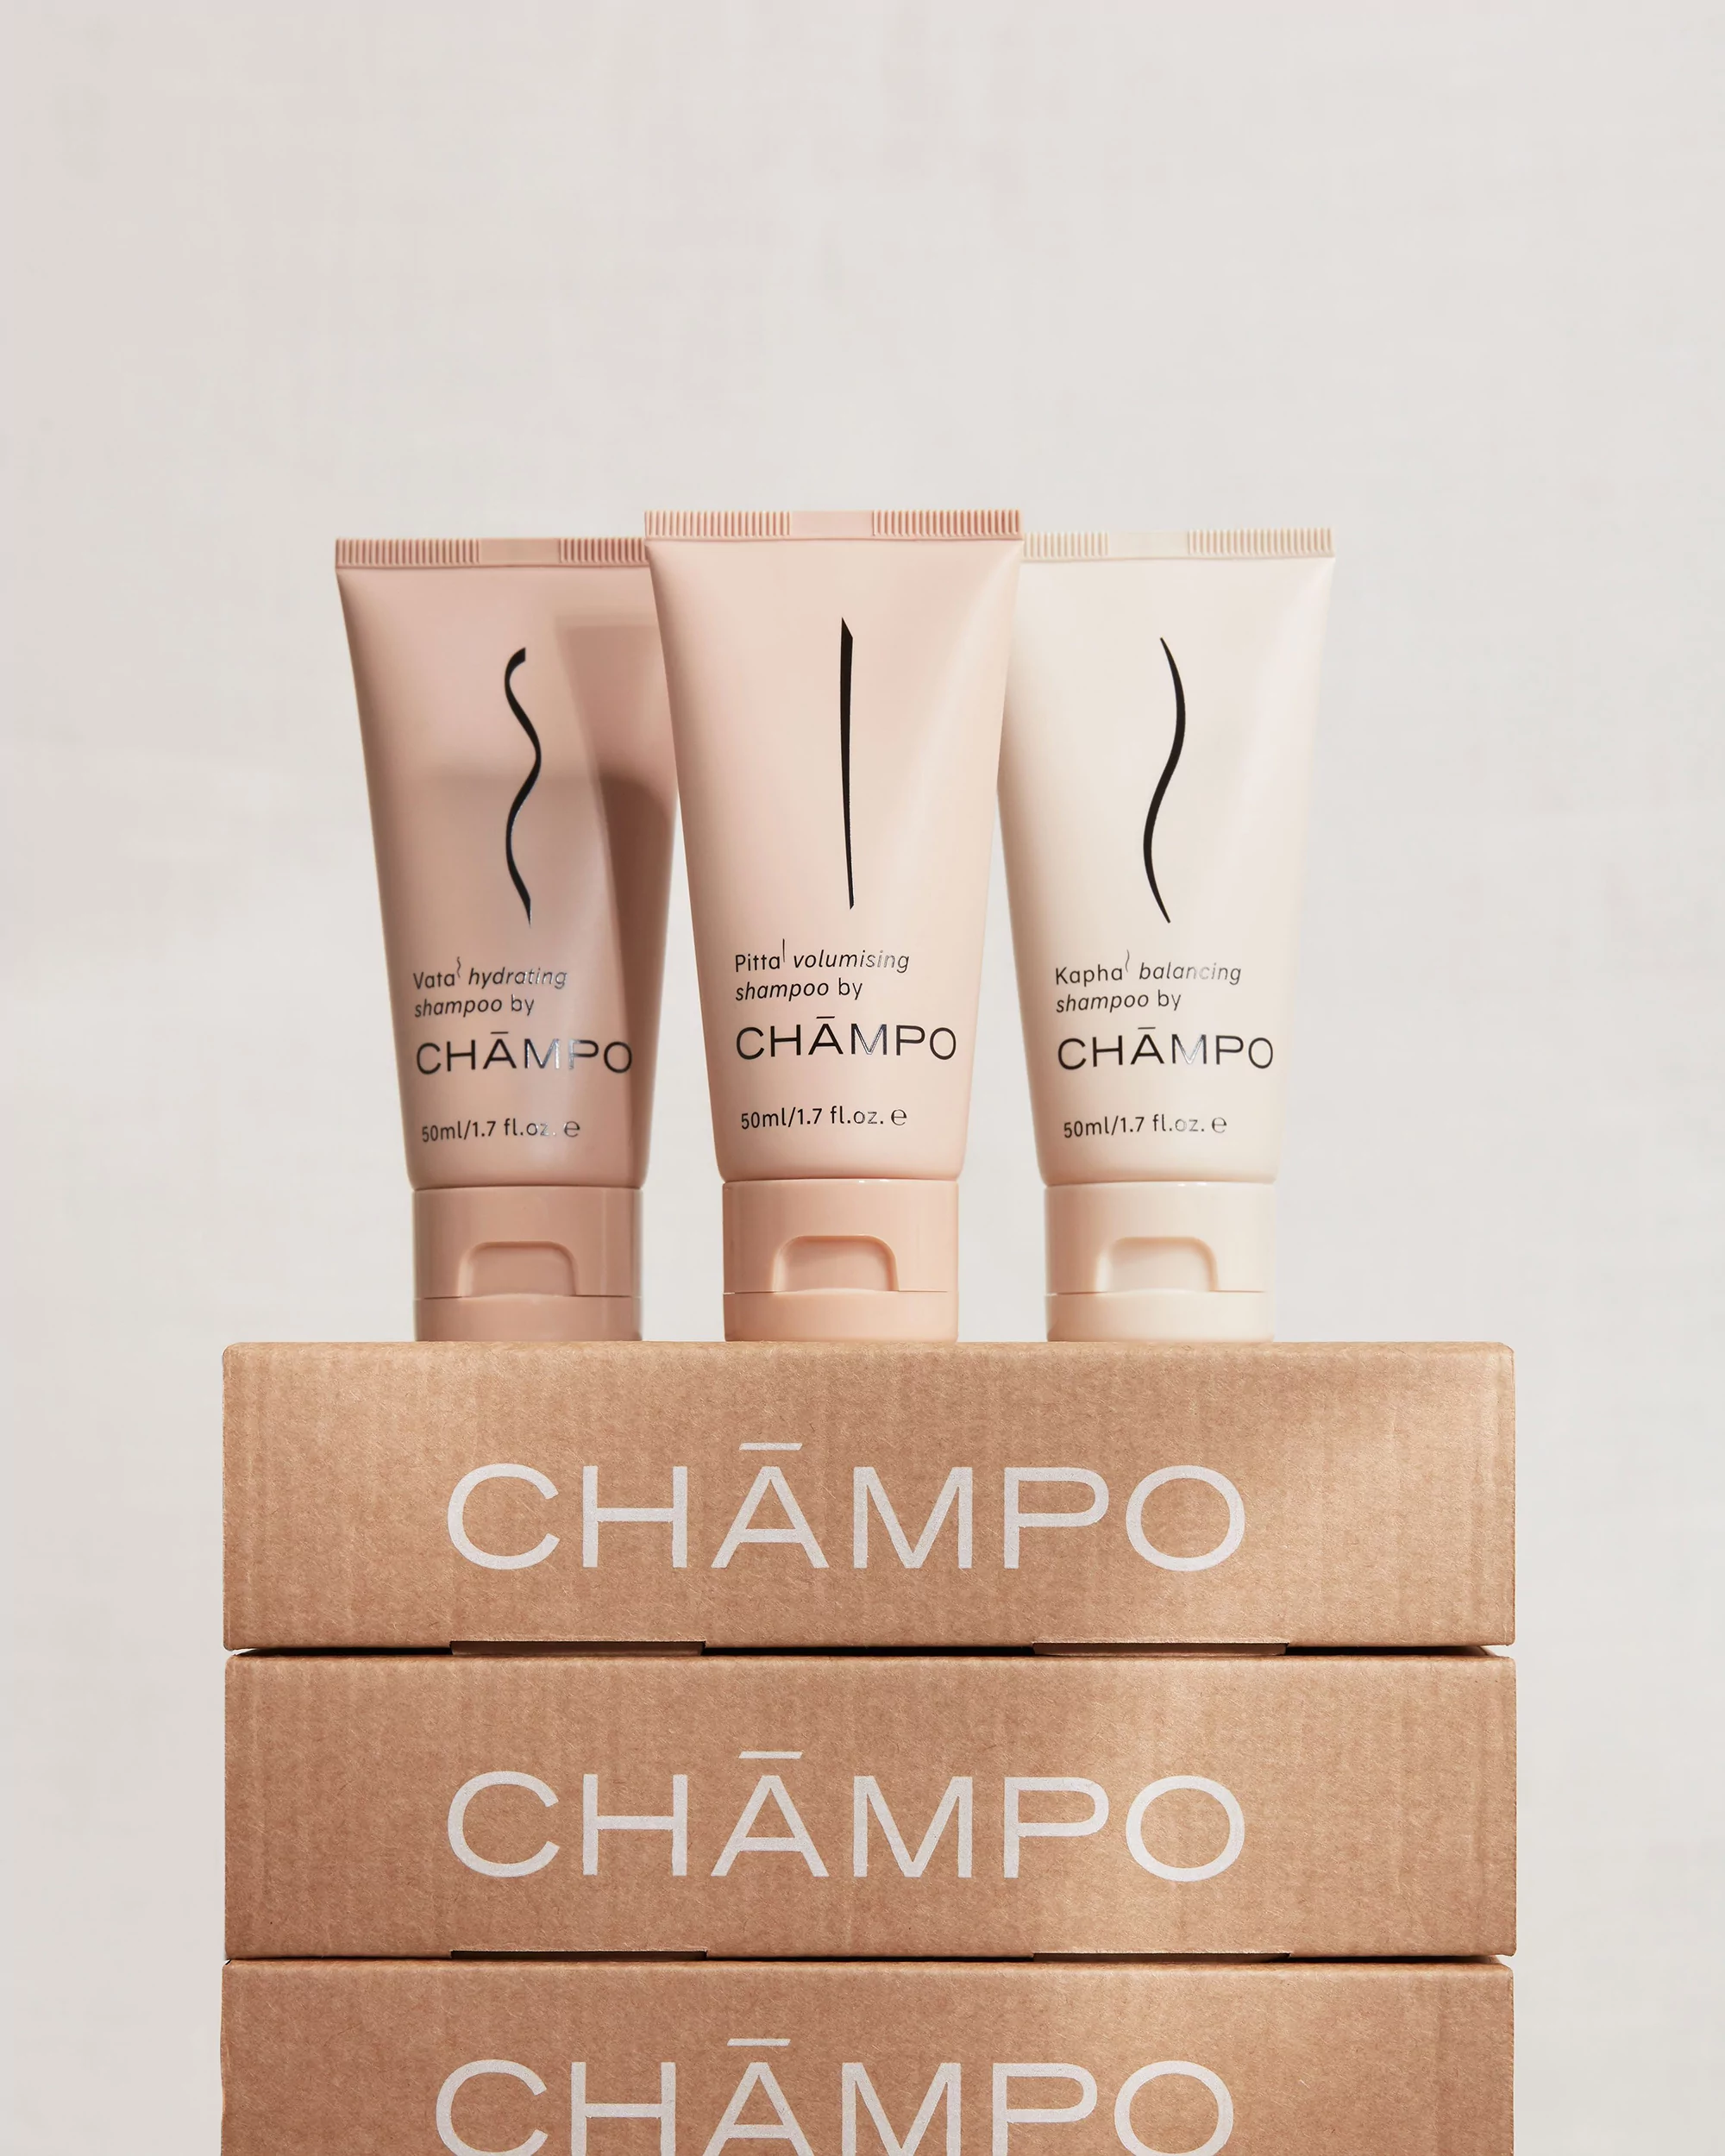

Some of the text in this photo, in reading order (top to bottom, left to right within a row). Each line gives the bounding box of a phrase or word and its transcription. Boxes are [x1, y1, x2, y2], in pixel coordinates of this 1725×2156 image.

[735, 950, 910, 974] Pitta volumising
[1055, 962, 1242, 987] Kapha balancing
[413, 967, 568, 990] Vata hydrating
[735, 977, 863, 1002] shampoo by
[414, 993, 535, 1018] shampoo by
[1056, 989, 1182, 1013] shampoo by
[736, 1016, 957, 1061] CHĀMPO
[1057, 1026, 1274, 1070] CHĀMPO
[416, 1031, 633, 1075] CHĀMPO
[422, 1119, 497, 1143] 50ml/1.7
[504, 1118, 557, 1137] fl.oz.
[741, 1106, 823, 1130] 50ml/1.7
[830, 1106, 885, 1125] fl.oz.
[1063, 1115, 1145, 1138] 50ml/1.7
[1152, 1113, 1206, 1132] fl.oz.
[446, 1443, 1247, 1573] CHĀMPO
[446, 1752, 1247, 1883] CHĀMPO
[435, 2039, 1234, 2156] CHĀMPO
